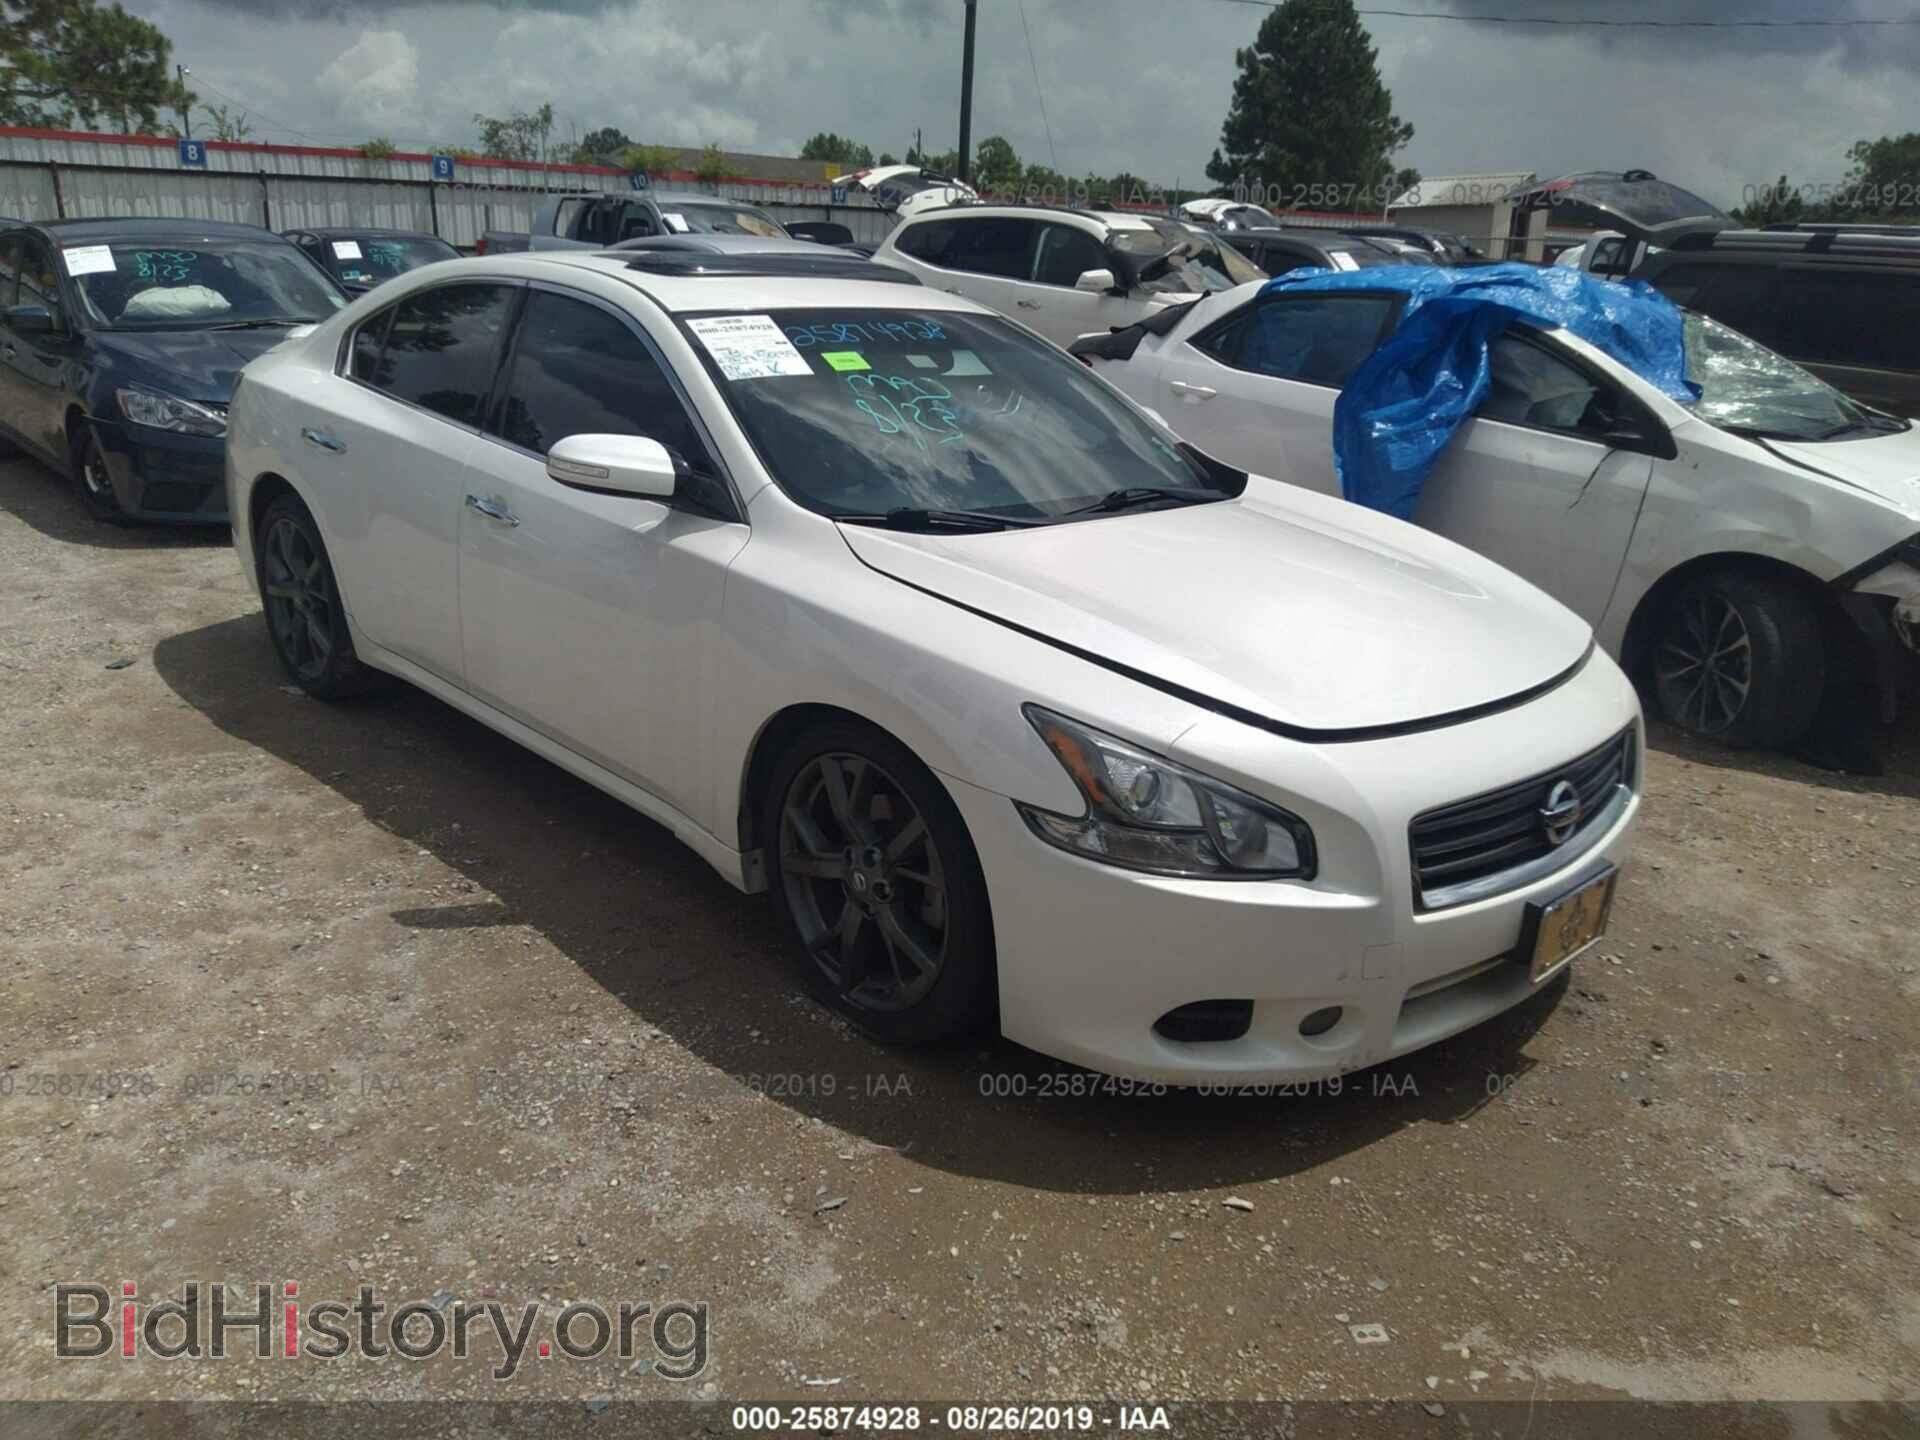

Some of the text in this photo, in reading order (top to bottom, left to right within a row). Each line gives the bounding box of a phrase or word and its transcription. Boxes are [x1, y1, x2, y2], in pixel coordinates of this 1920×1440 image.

[187, 144, 198, 161] 8
[439, 160, 448, 175] 9
[633, 174, 647, 189] 10
[784, 320, 946, 346] 25874928
